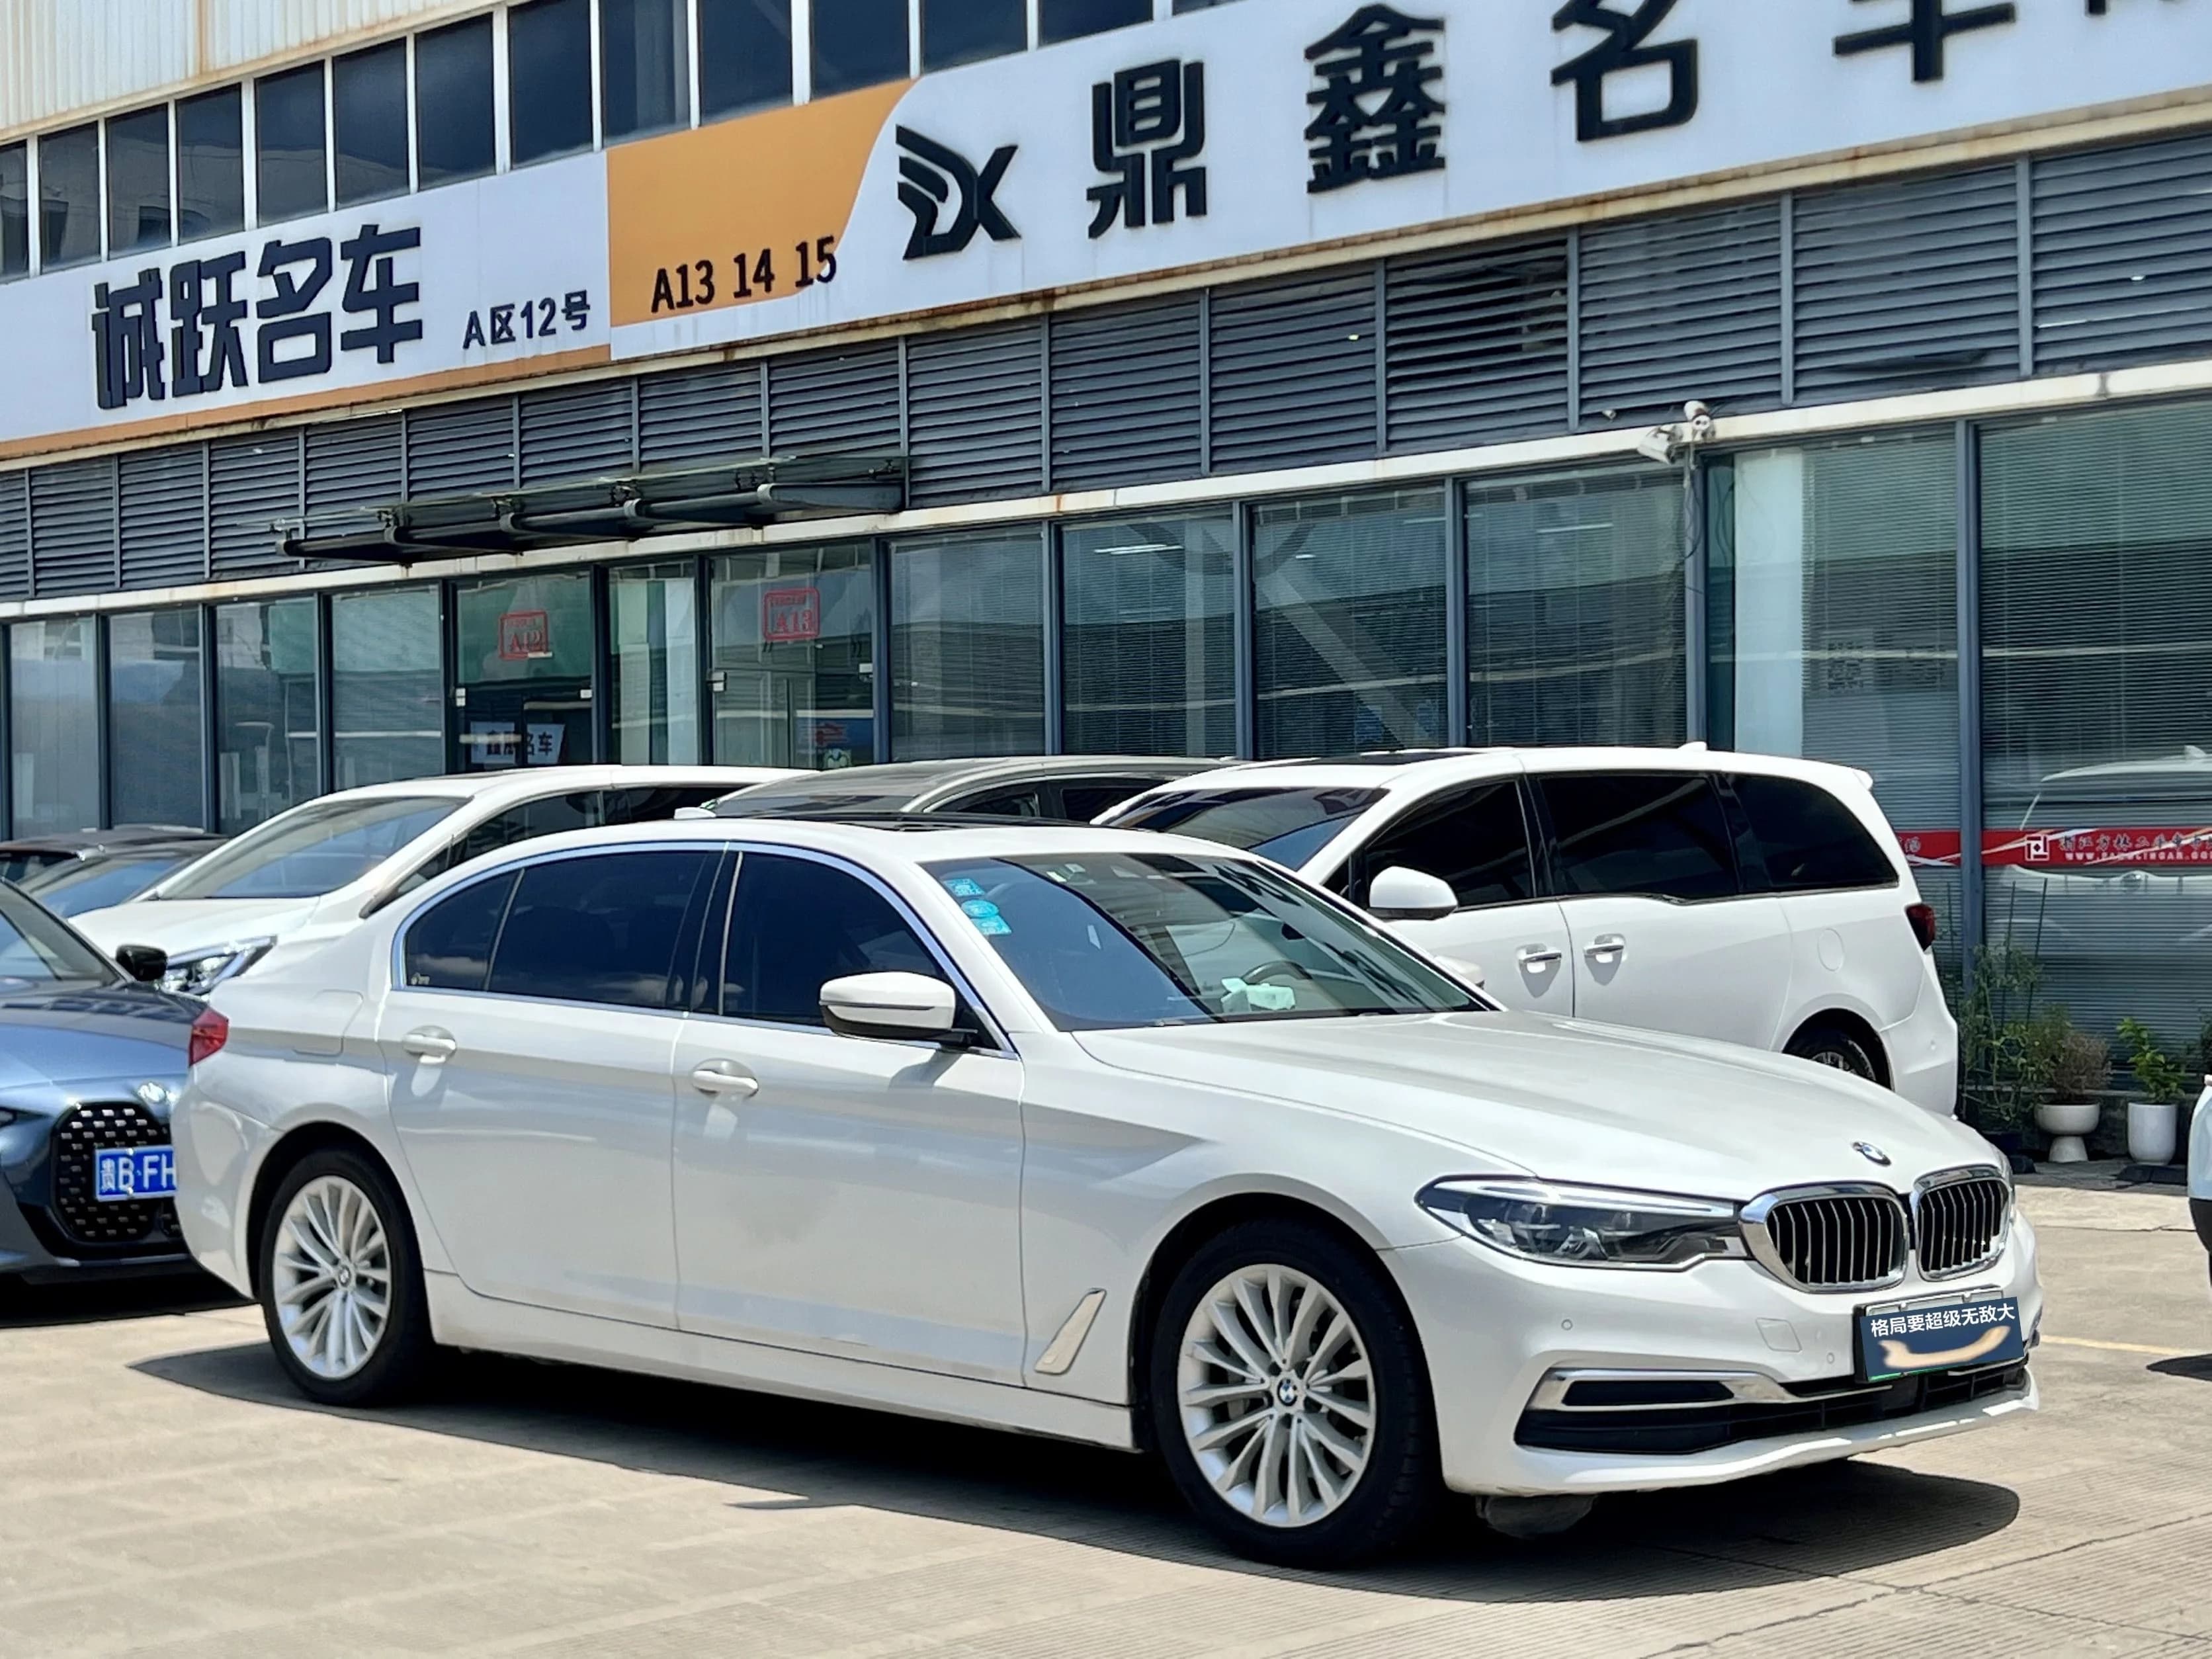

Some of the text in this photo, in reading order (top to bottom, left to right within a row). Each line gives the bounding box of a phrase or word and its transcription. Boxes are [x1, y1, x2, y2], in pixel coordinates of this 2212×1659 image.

[651, 236, 837, 314] A13 14 15
[91, 224, 423, 410] 诚跃名车
[463, 289, 591, 349] A区12号
